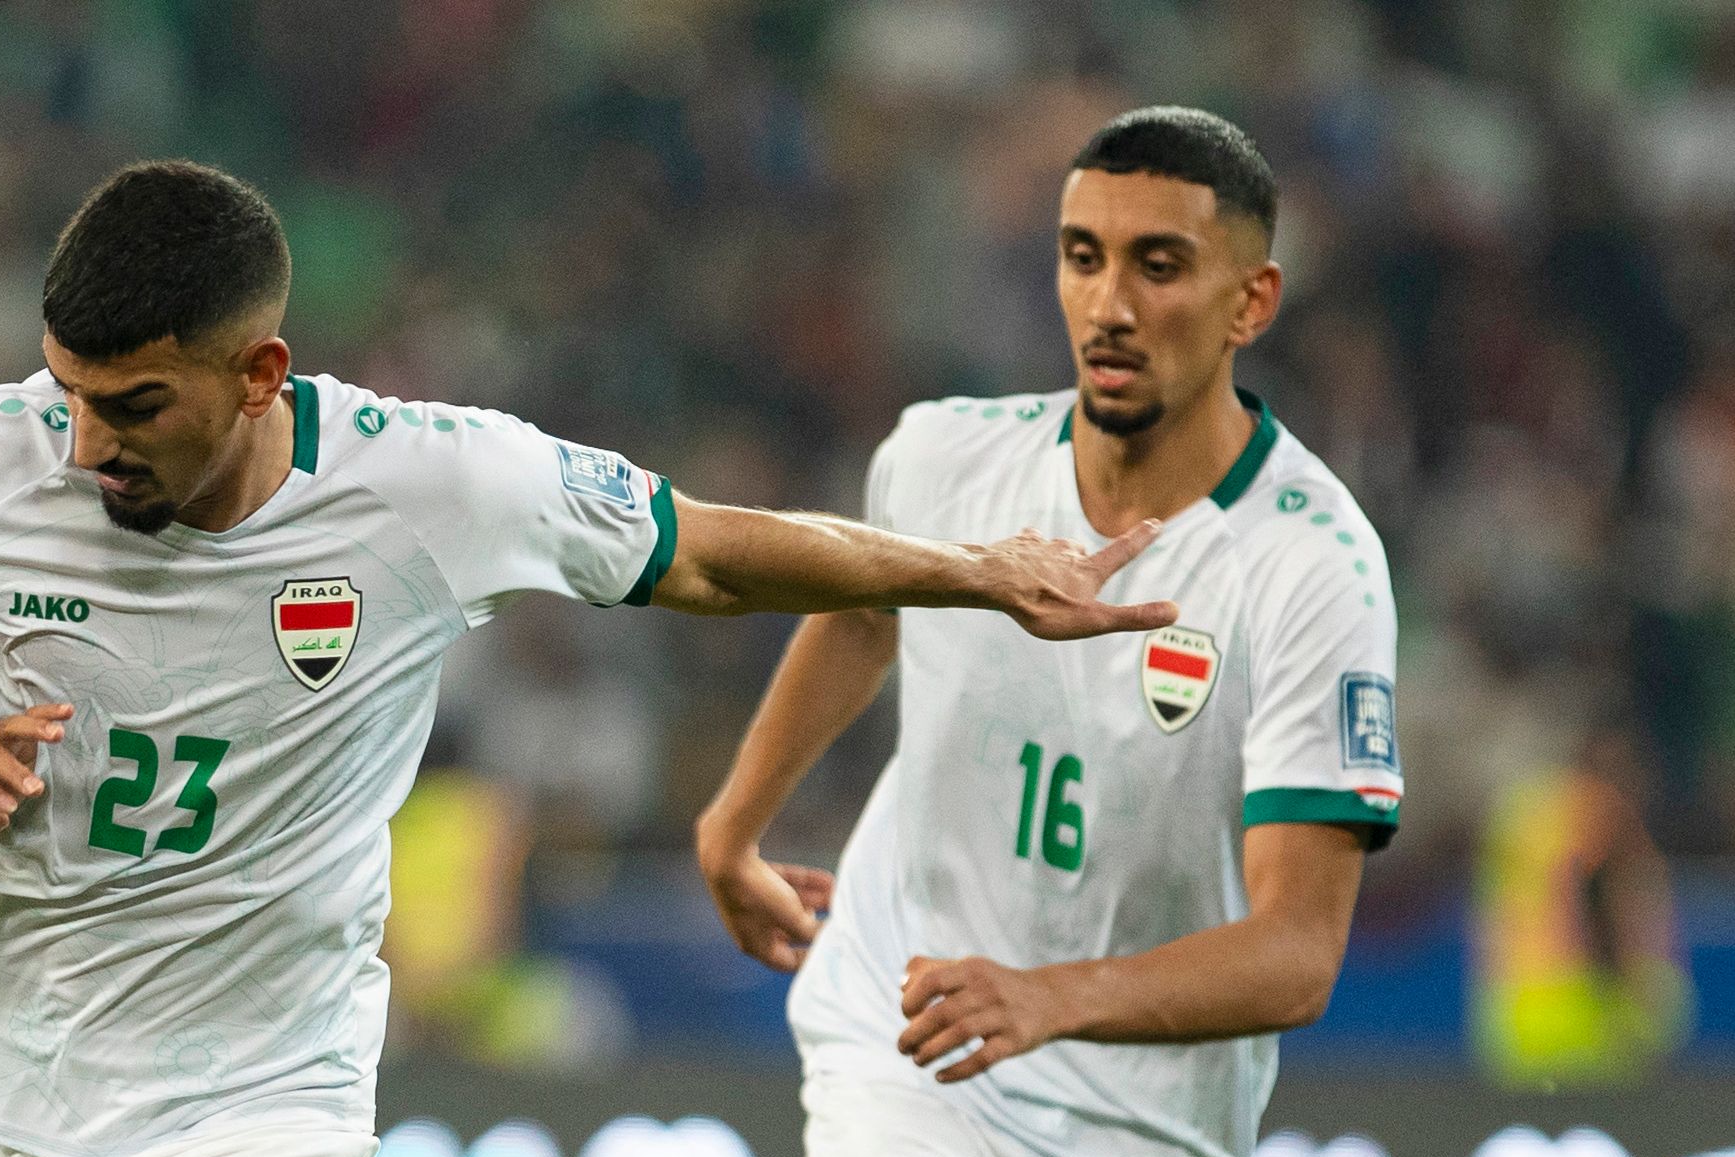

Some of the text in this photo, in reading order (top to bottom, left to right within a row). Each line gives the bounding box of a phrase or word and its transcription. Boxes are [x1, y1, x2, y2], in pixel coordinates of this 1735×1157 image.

[9, 592, 90, 623] JAKO
[292, 586, 342, 598] IRAQ
[88, 728, 233, 858] 23
[1018, 739, 1085, 873] 16
